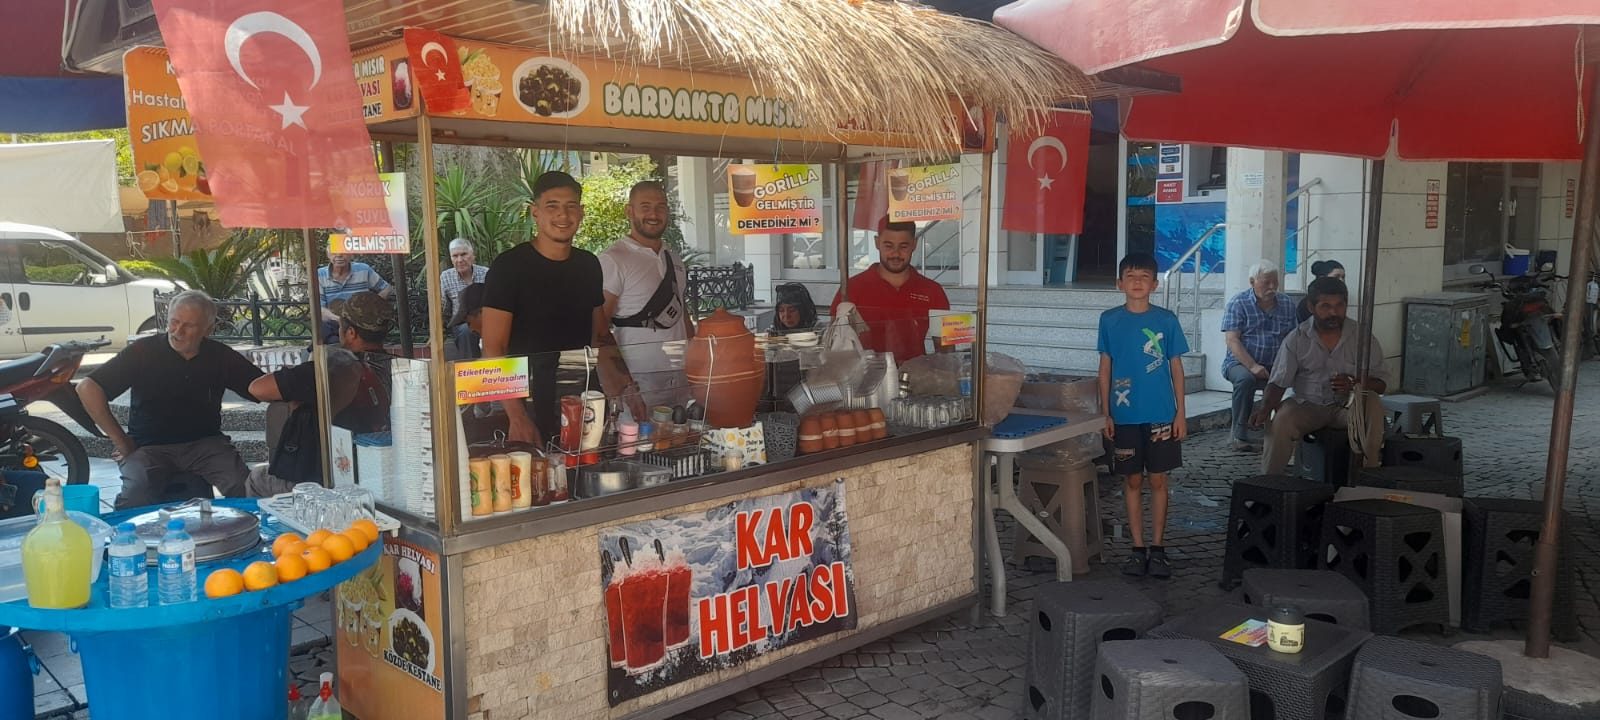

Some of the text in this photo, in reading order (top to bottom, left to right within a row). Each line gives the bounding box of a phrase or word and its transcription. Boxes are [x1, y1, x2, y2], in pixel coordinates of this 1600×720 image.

[361, 80, 380, 96] VASI
[603, 82, 741, 124] BARDAKTA
[753, 168, 819, 199] GORİLLA
[907, 167, 960, 194] GORİLLA
[756, 195, 815, 211] GELMİŞTİR
[737, 216, 797, 229] DENEDİNİZ
[799, 215, 812, 227] Mİ
[344, 230, 405, 254] GELMİŞTİR
[735, 501, 815, 571] KAR
[401, 545, 436, 575] HELVASI
[698, 562, 849, 660] HELVASI
